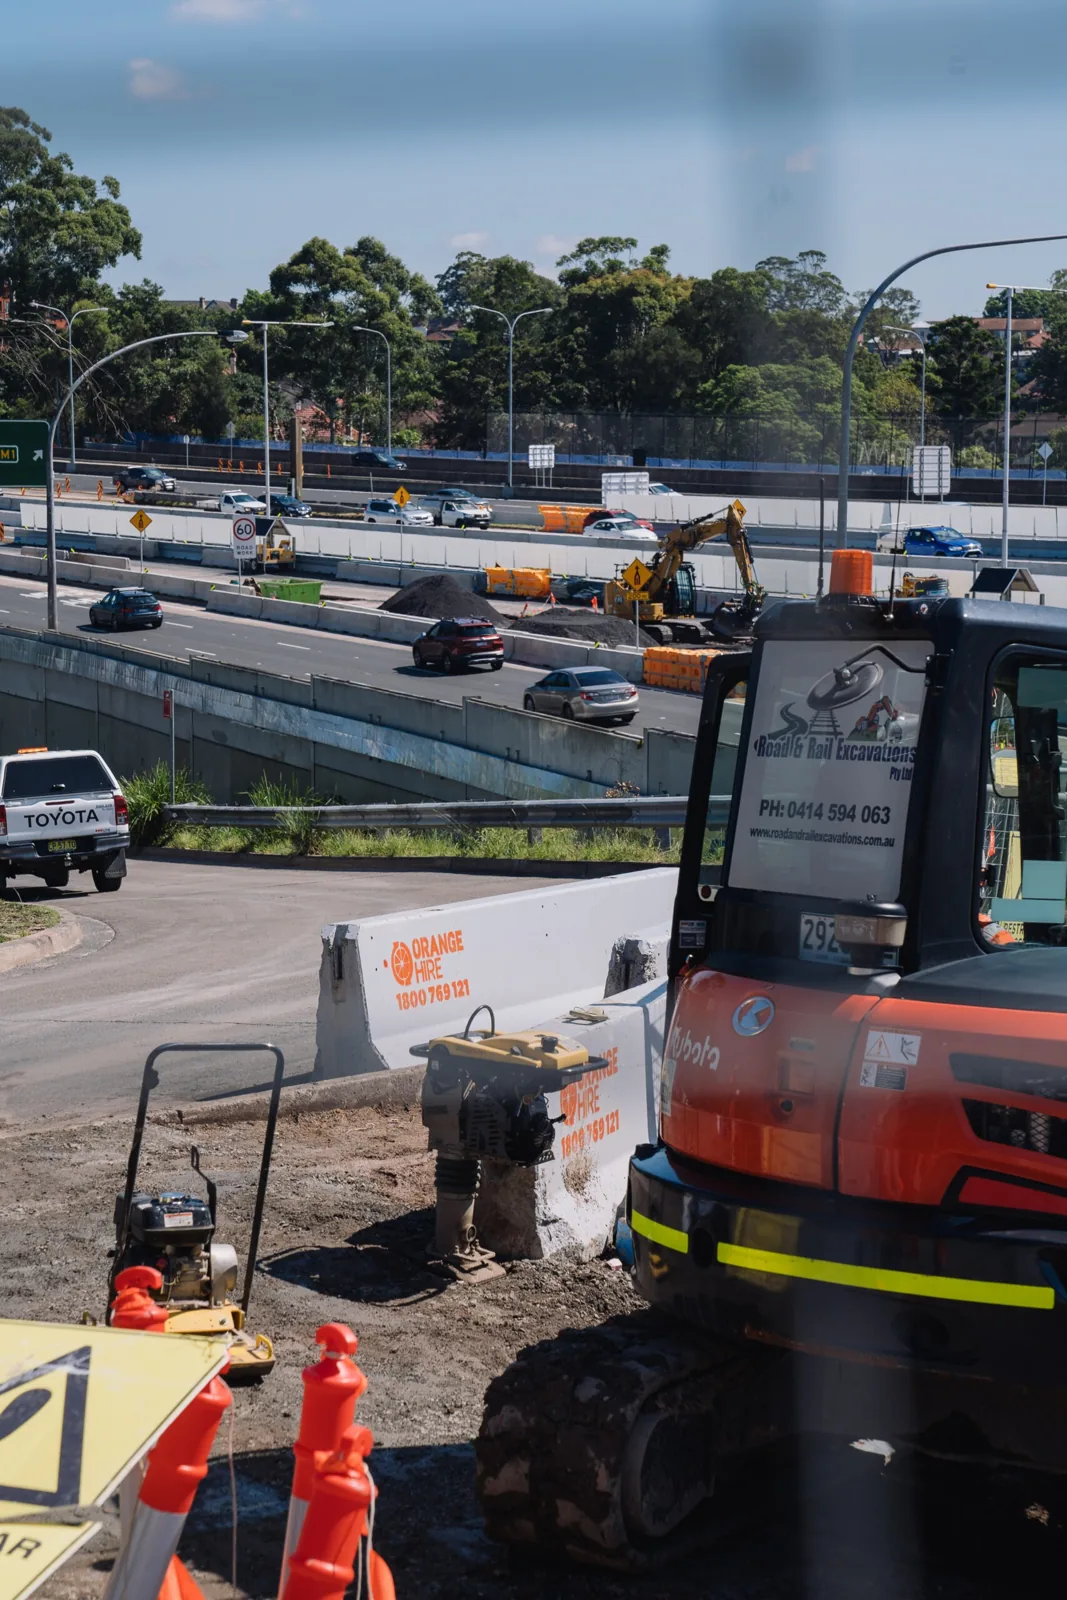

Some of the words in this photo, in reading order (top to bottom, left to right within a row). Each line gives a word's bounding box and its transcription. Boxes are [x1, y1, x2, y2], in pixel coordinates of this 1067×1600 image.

[1, 449, 15, 460] M1
[237, 524, 252, 535] 60
[756, 735, 790, 758] Road
[807, 737, 834, 760] Rail
[836, 738, 917, 764] Excavations
[889, 766, 901, 781] Pty
[24, 809, 100, 828] TOYOTA
[759, 799, 785, 818] PH:
[787, 801, 824, 820] 0414
[827, 803, 857, 823] 594
[861, 805, 891, 825] 063
[749, 828, 896, 848] www.roadandrailexcavations.com.au
[411, 929, 464, 959] ORANGE
[414, 957, 443, 983] HIRE
[396, 988, 427, 1011] 1800
[428, 983, 451, 1004] 769
[451, 978, 470, 998] 121
[670, 1026, 720, 1070] Kubota
[577, 1084, 600, 1120] HIRE
[561, 1127, 585, 1160] 1800
[586, 1117, 605, 1143] 769
[605, 1108, 620, 1135] 121
